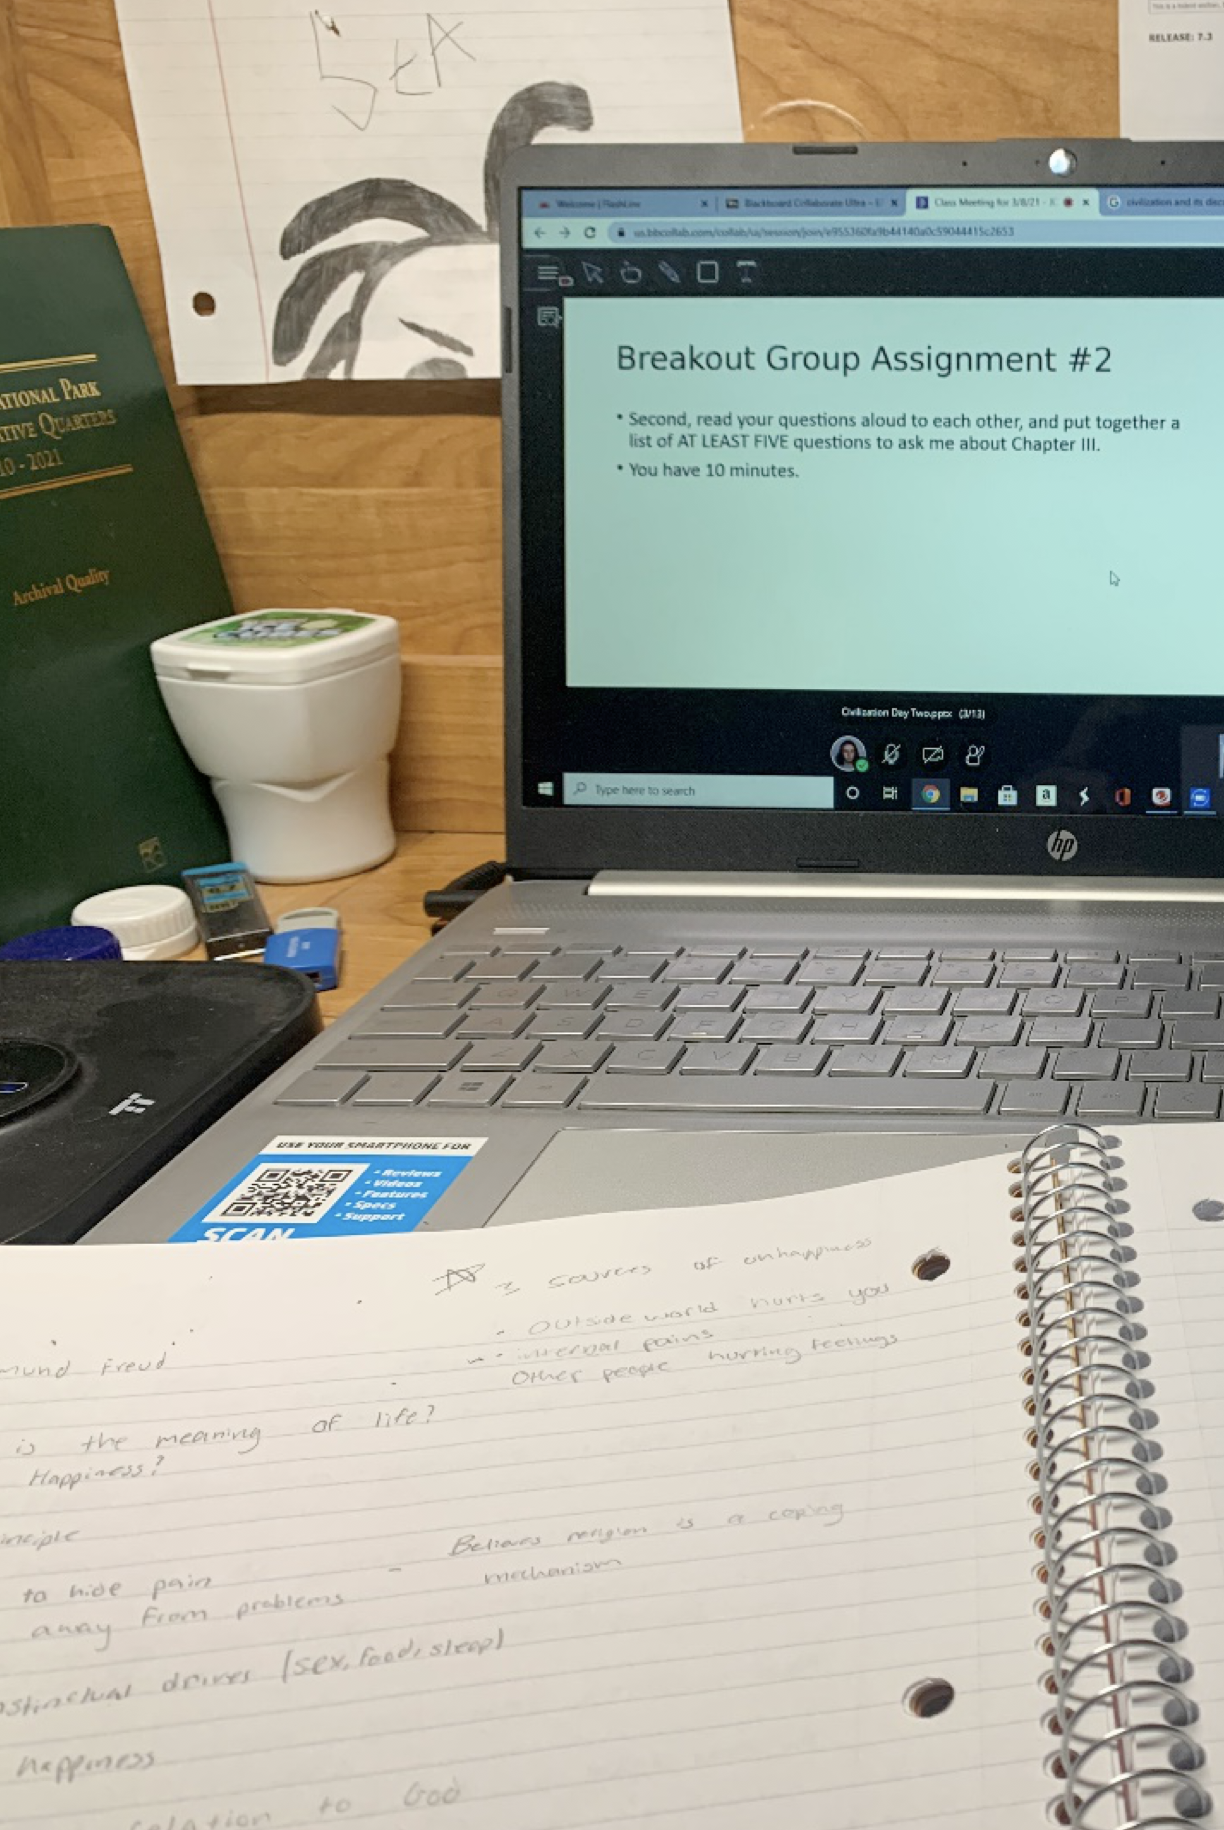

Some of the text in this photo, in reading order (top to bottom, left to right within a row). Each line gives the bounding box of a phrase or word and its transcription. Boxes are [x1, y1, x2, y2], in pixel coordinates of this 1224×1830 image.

[1148, 32, 1194, 42] RELEASE:
[618, 344, 1110, 377] Breakout Group Assignment #2
[59, 378, 101, 400] PARK
[38, 409, 118, 440] QUARTERS
[629, 411, 1180, 433] Second, read your questions aloud to each other, and put together a
[628, 432, 1100, 454] list of AT LEAST FIVE questions to ask me about Chapter III.
[26, 449, 63, 471] 2021
[629, 463, 799, 478] You have 10 minutes.
[14, 568, 110, 606] Archival Quality
[892, 707, 910, 720] Day
[595, 784, 695, 798] Type here to search
[1047, 830, 1078, 860] hp
[275, 1141, 472, 1150] USE YOUR SMARTPHONE FOR
[373, 1179, 424, 1188] Videos
[381, 1169, 442, 1178] Reviews
[352, 1201, 397, 1210] Specs
[362, 1190, 428, 1199] Features
[342, 1212, 406, 1222] Support
[81, 1405, 436, 1456] the meaning of life?
[28, 1455, 166, 1492] Happiness?
[153, 1575, 214, 1600] pain
